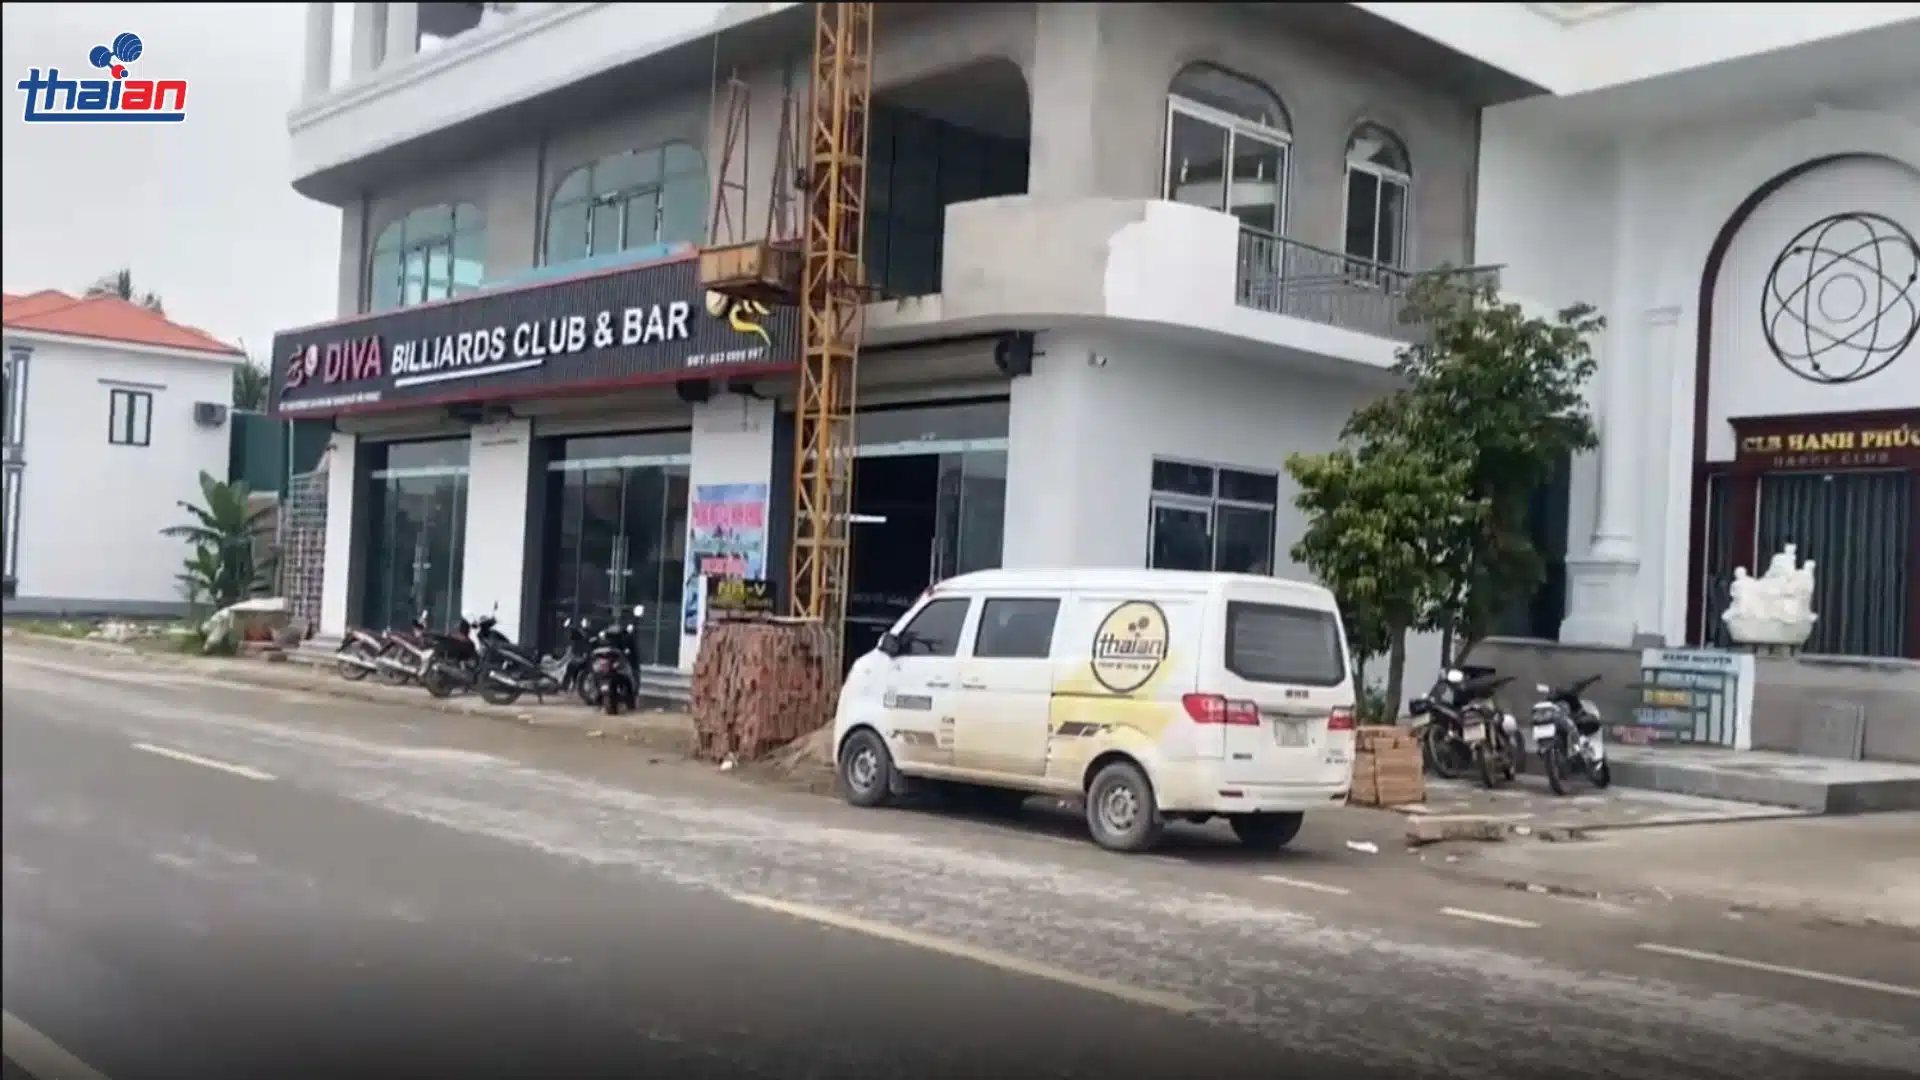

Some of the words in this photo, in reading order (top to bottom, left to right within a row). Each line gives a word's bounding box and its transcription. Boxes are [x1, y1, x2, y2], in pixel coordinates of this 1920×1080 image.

[323, 335, 382, 384] DIVA
[390, 326, 506, 375] BILLIARDS
[513, 316, 586, 357] CLUB
[594, 311, 613, 347] &
[622, 301, 689, 345] BAR
[1743, 435, 1782, 452] CLB
